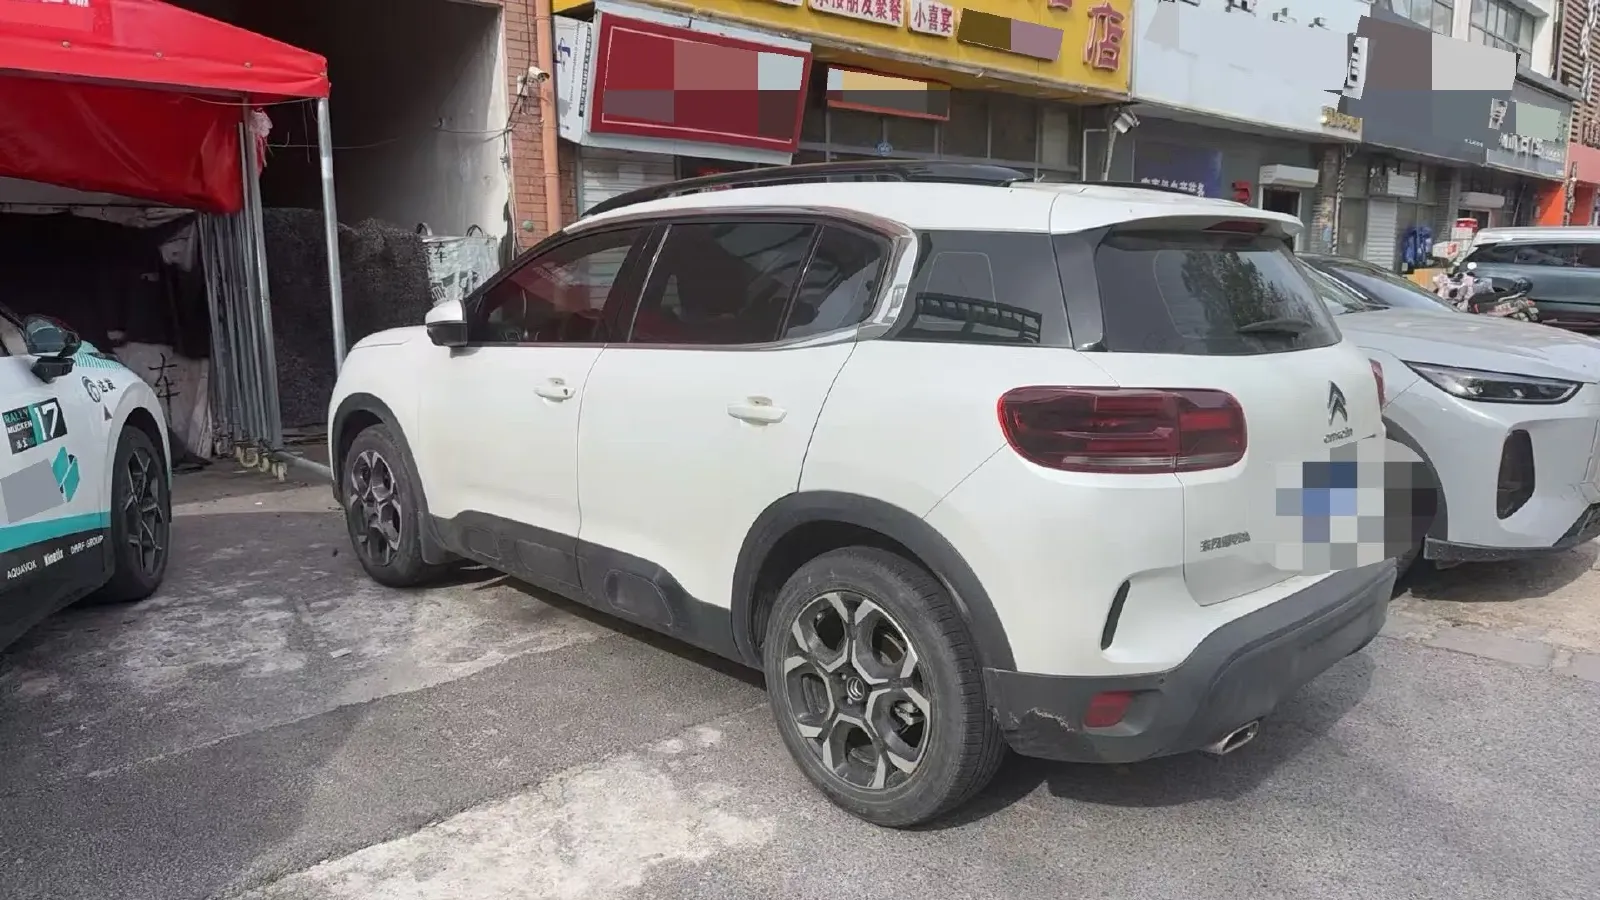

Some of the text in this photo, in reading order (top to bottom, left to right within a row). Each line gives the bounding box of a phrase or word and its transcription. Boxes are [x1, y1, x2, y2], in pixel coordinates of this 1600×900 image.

[913, 2, 953, 33] 小喜宴
[4, 408, 30, 424] RALLY
[34, 402, 58, 440] 17
[86, 534, 104, 548] GROUP
[7, 559, 37, 579] AQUAVOX
